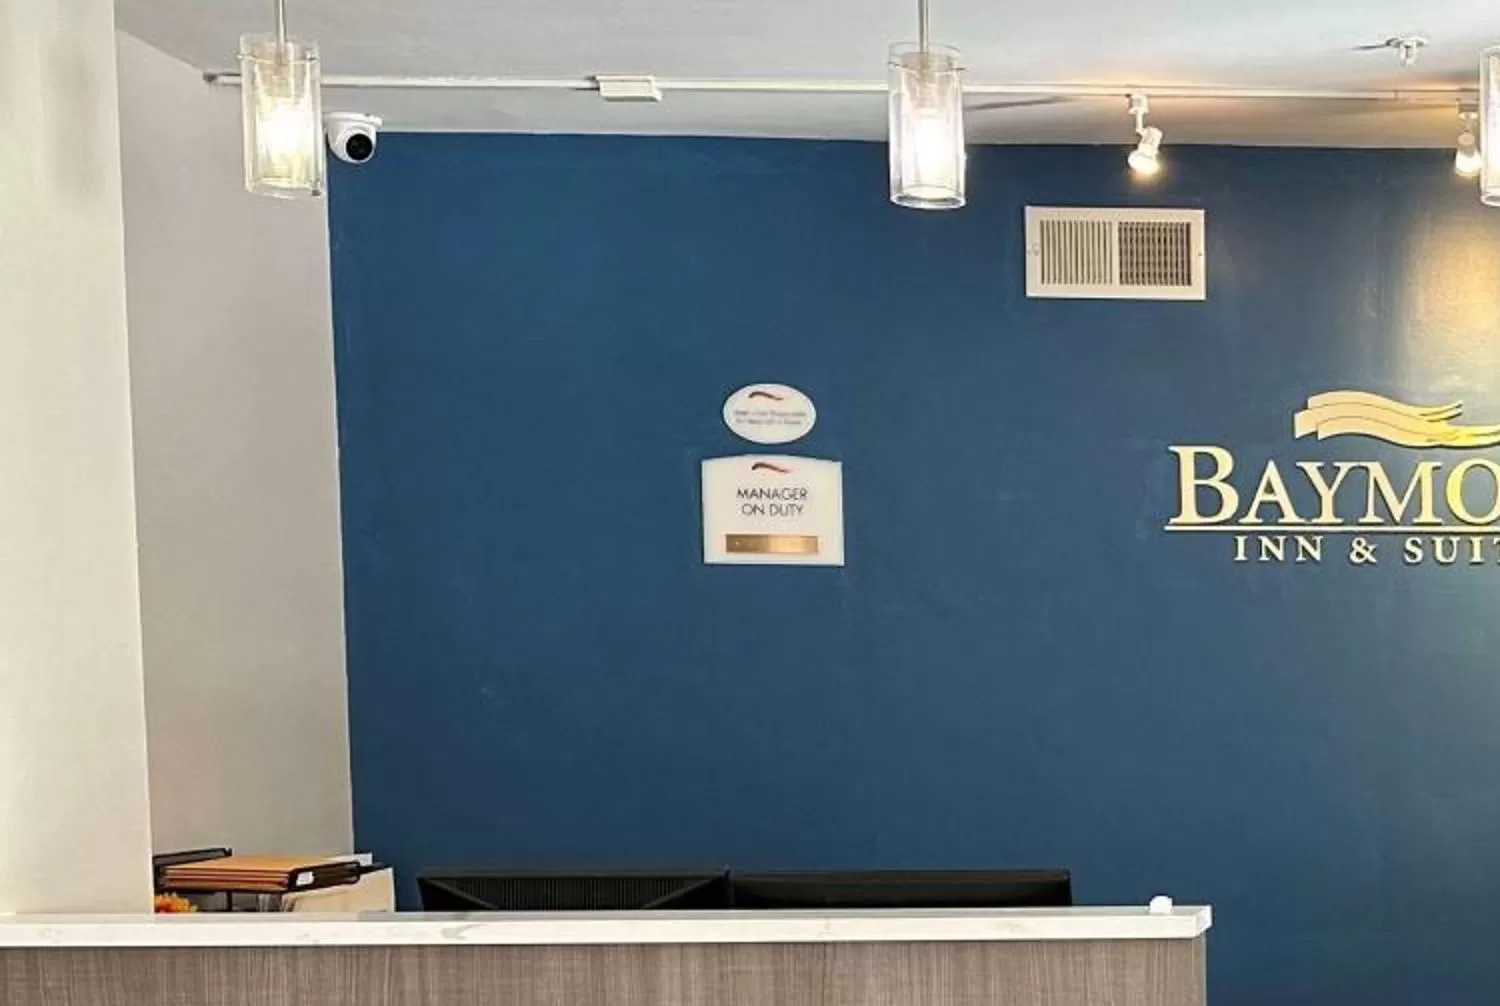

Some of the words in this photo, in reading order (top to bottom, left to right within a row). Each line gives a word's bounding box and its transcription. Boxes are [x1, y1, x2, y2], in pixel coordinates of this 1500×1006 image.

[736, 487, 808, 501] MANAGER
[741, 503, 765, 516] ON
[769, 503, 804, 517] DUTY
[1233, 535, 1324, 563] INN
[1349, 537, 1378, 564] &
